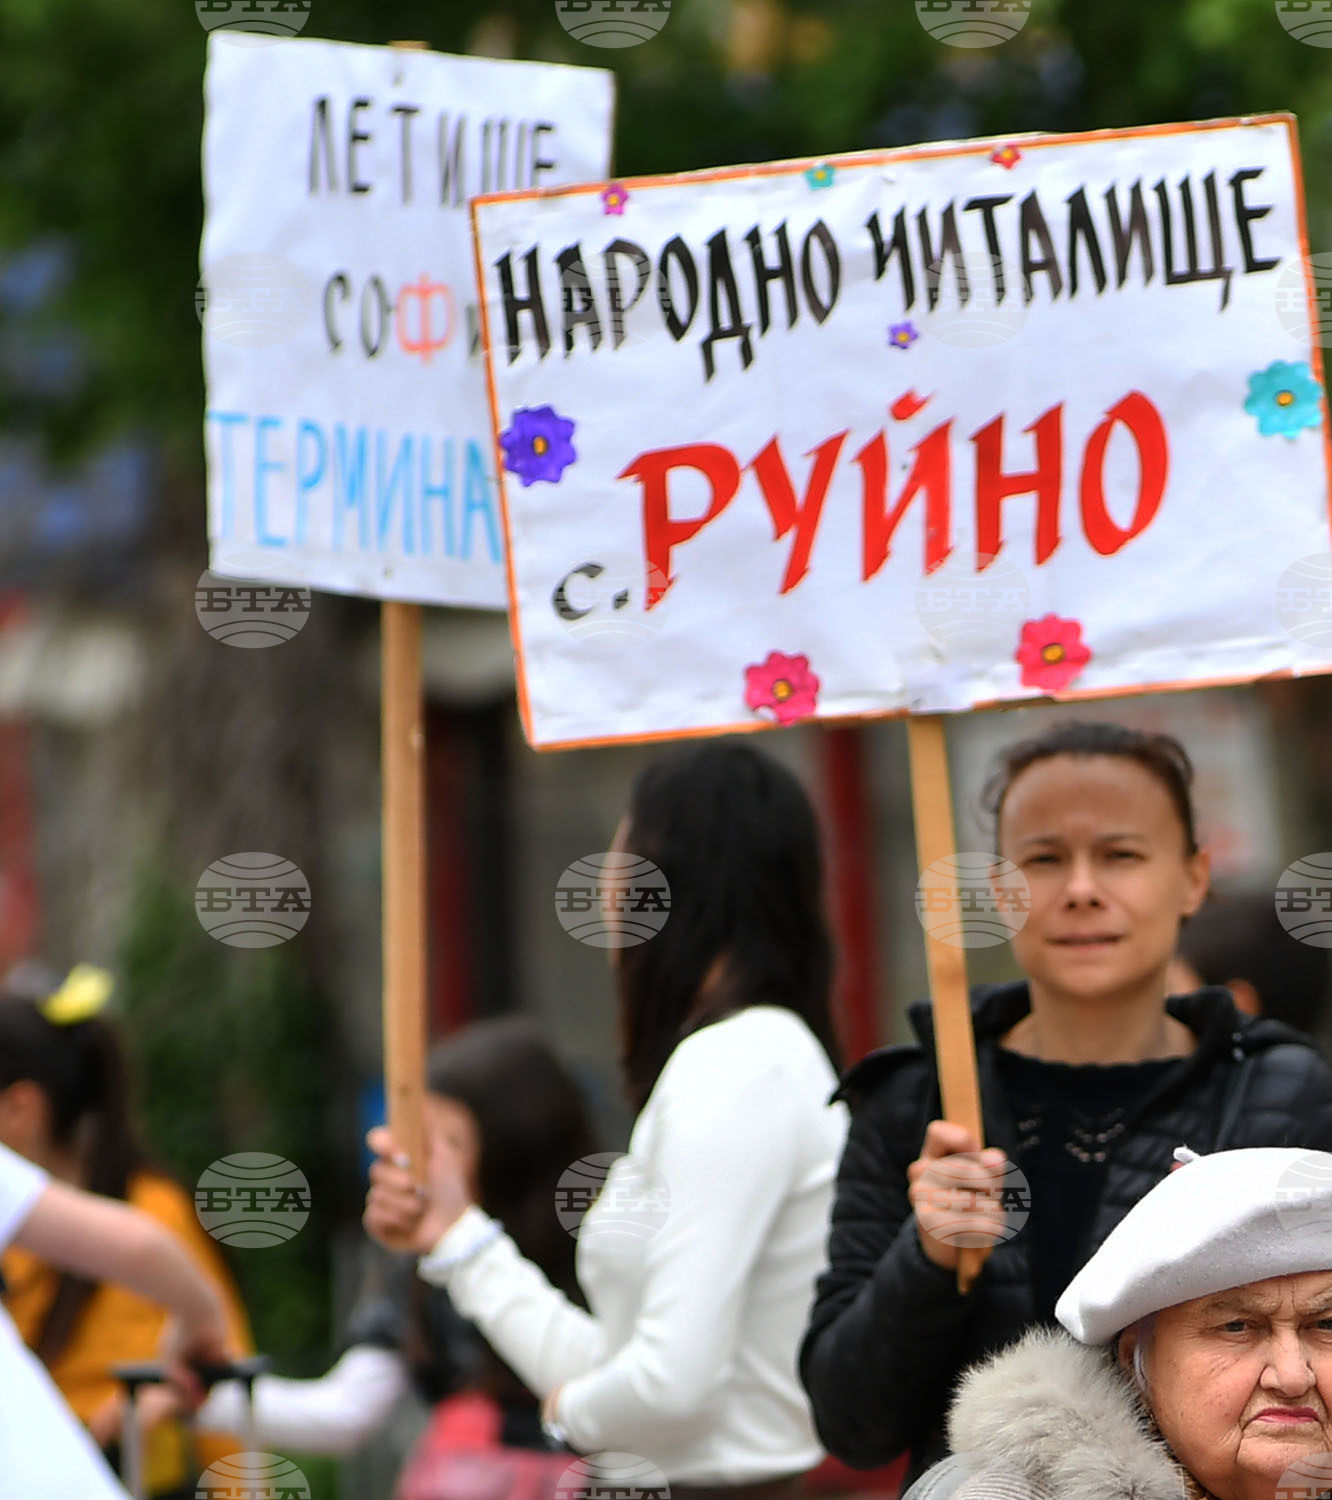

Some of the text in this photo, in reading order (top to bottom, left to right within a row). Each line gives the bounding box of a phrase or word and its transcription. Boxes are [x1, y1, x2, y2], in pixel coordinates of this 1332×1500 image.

[494, 167, 1284, 382] НАРОДНО ЧИТАЛИЩЕ
[618, 388, 1169, 611] РУЙНО
